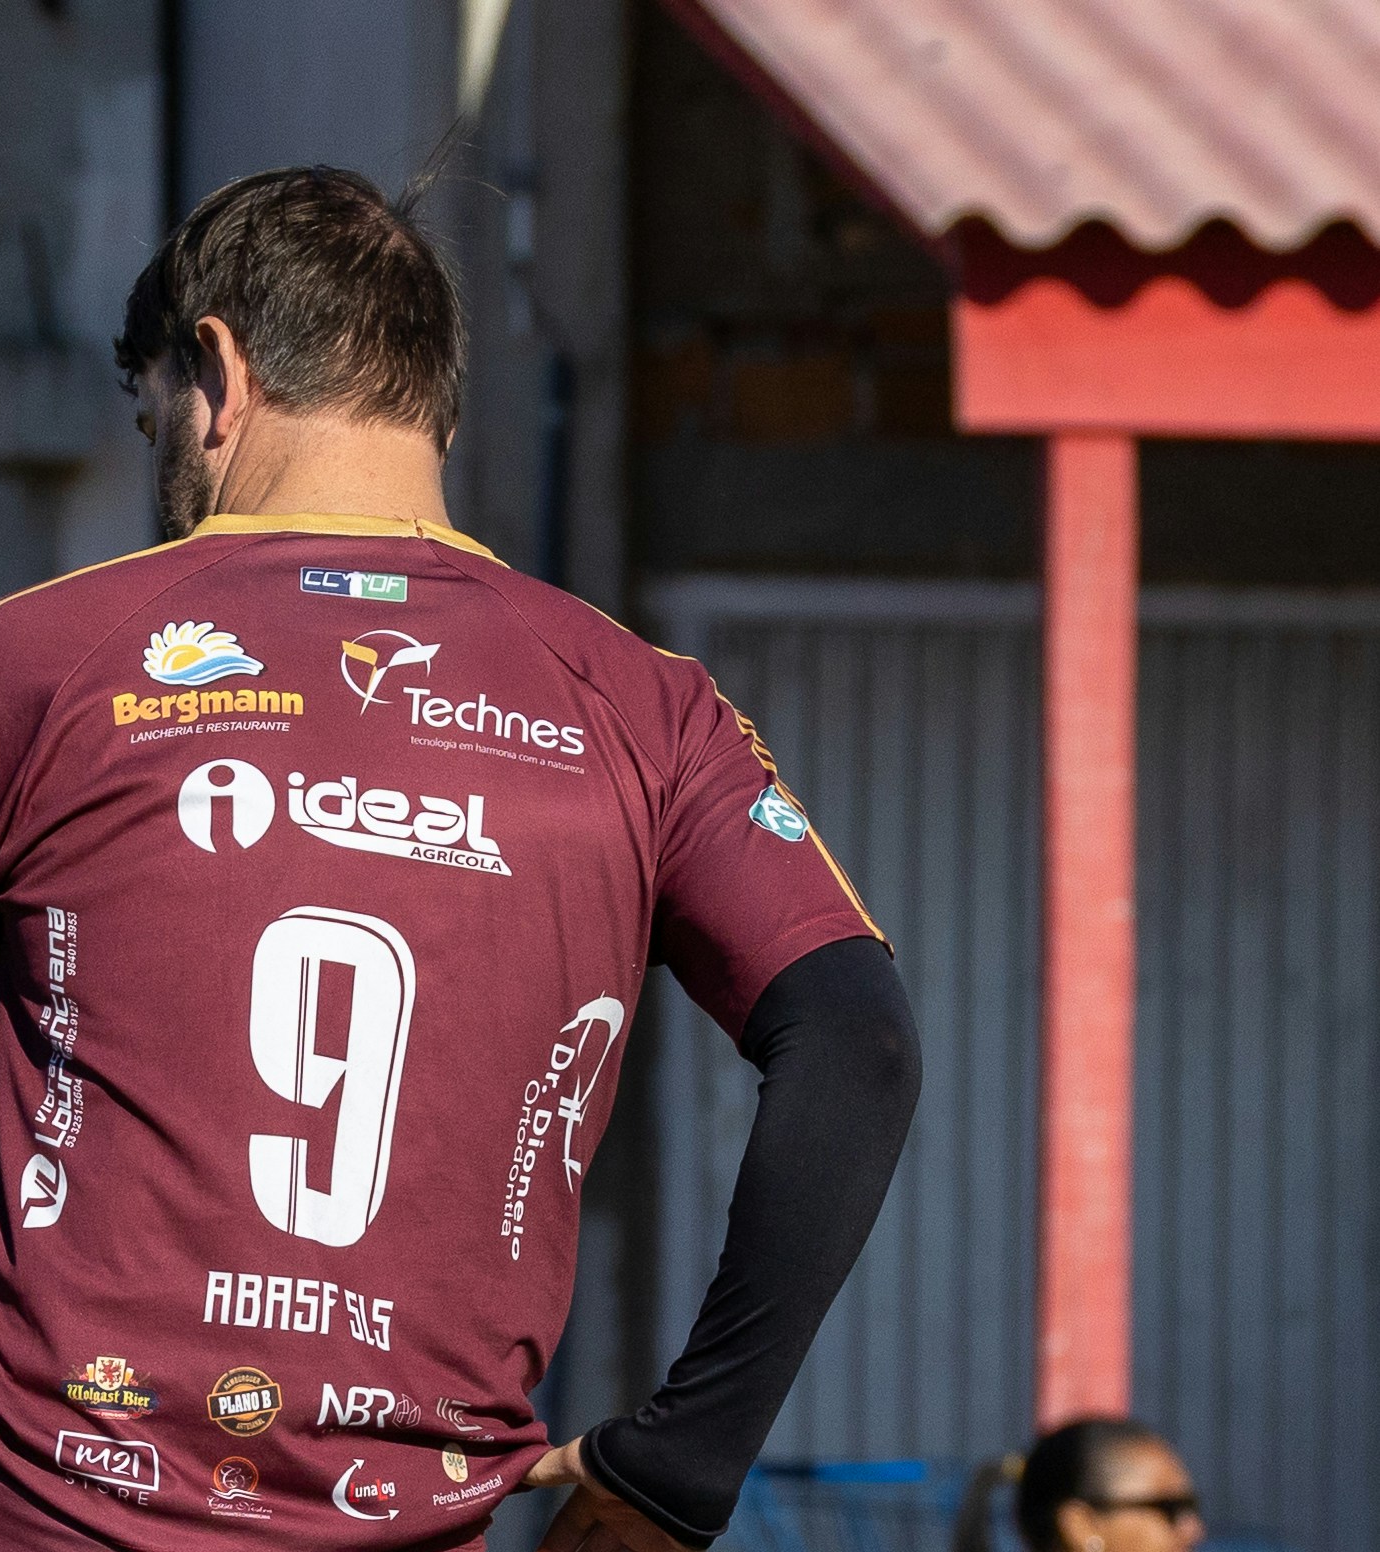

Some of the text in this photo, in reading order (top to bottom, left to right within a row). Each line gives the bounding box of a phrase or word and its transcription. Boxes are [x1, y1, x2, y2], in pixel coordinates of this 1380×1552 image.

[112, 689, 304, 726] Bergmann
[403, 687, 585, 755] Technes
[130, 720, 291, 743] LANCHERIA E RESTAURANTE
[410, 735, 457, 750] tecnologia
[459, 743, 474, 752] em
[475, 743, 517, 761] harmonia
[518, 753, 538, 765] com
[547, 760, 585, 775] natureza
[288, 771, 502, 856] ideal
[409, 847, 503, 872] AGRÍCOLA
[66, 912, 78, 976] 98401.3953
[249, 905, 417, 1248] 9
[541, 1043, 575, 1094] Dr.
[65, 1135, 77, 1148] 53
[501, 1080, 540, 1237] Ortodontia
[202, 1270, 394, 1352] ABASF SLS
[67, 1384, 151, 1408] Wolgast Bier
[218, 1390, 273, 1416] PLANO B
[64, 1473, 150, 1506] STORE
[348, 1478, 396, 1504] LunaLog
[432, 1492, 460, 1506] Pérola
[460, 1474, 504, 1500] Ambiental
